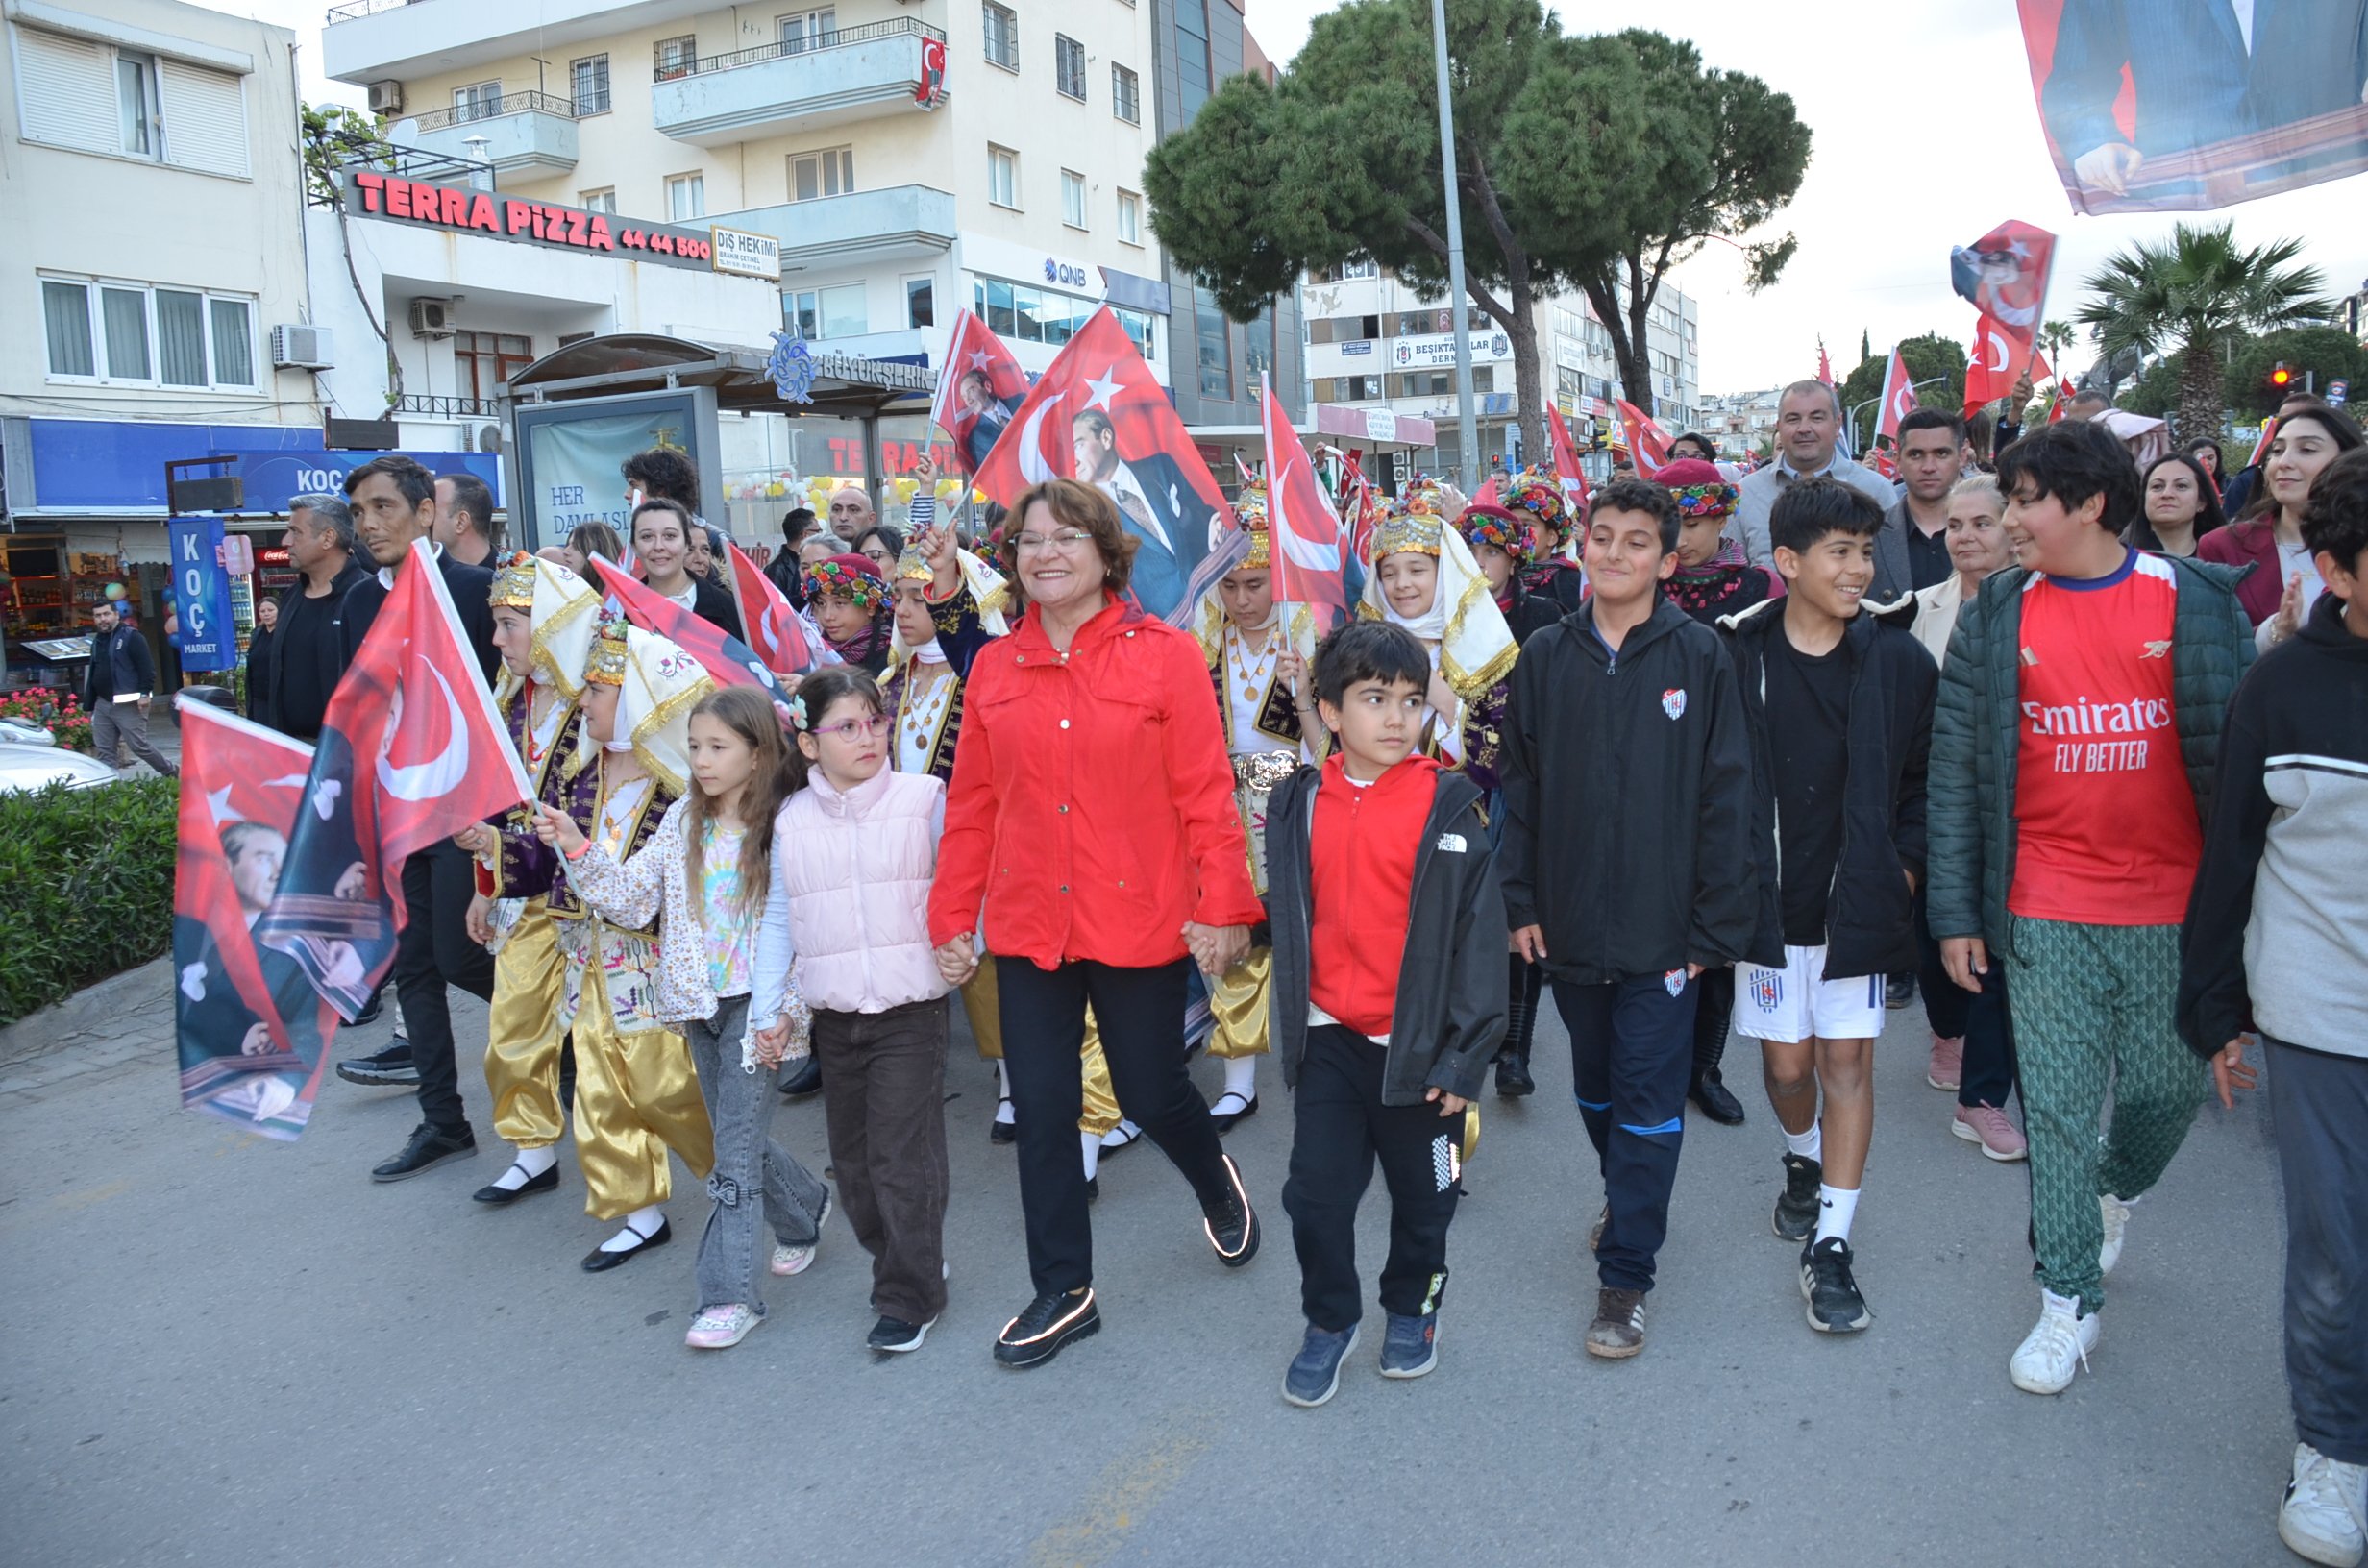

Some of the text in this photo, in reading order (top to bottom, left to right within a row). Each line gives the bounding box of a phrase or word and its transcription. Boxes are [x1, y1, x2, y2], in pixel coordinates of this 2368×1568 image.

[357, 173, 500, 232] TERRA
[622, 228, 646, 249] 44
[650, 233, 673, 254] 44
[676, 236, 711, 260] 500
[1059, 264, 1086, 287] QNB
[1416, 340, 1489, 355] BEŞİKTALAR
[823, 349, 930, 392] BÜYÜKŞEHİR
[828, 437, 920, 475] TERA
[297, 469, 344, 496] KOÇ
[551, 485, 584, 506] HER
[185, 643, 217, 654] MARKET
[2021, 696, 2170, 735] Emirates
[2054, 740, 2148, 772] FLY BETTER
